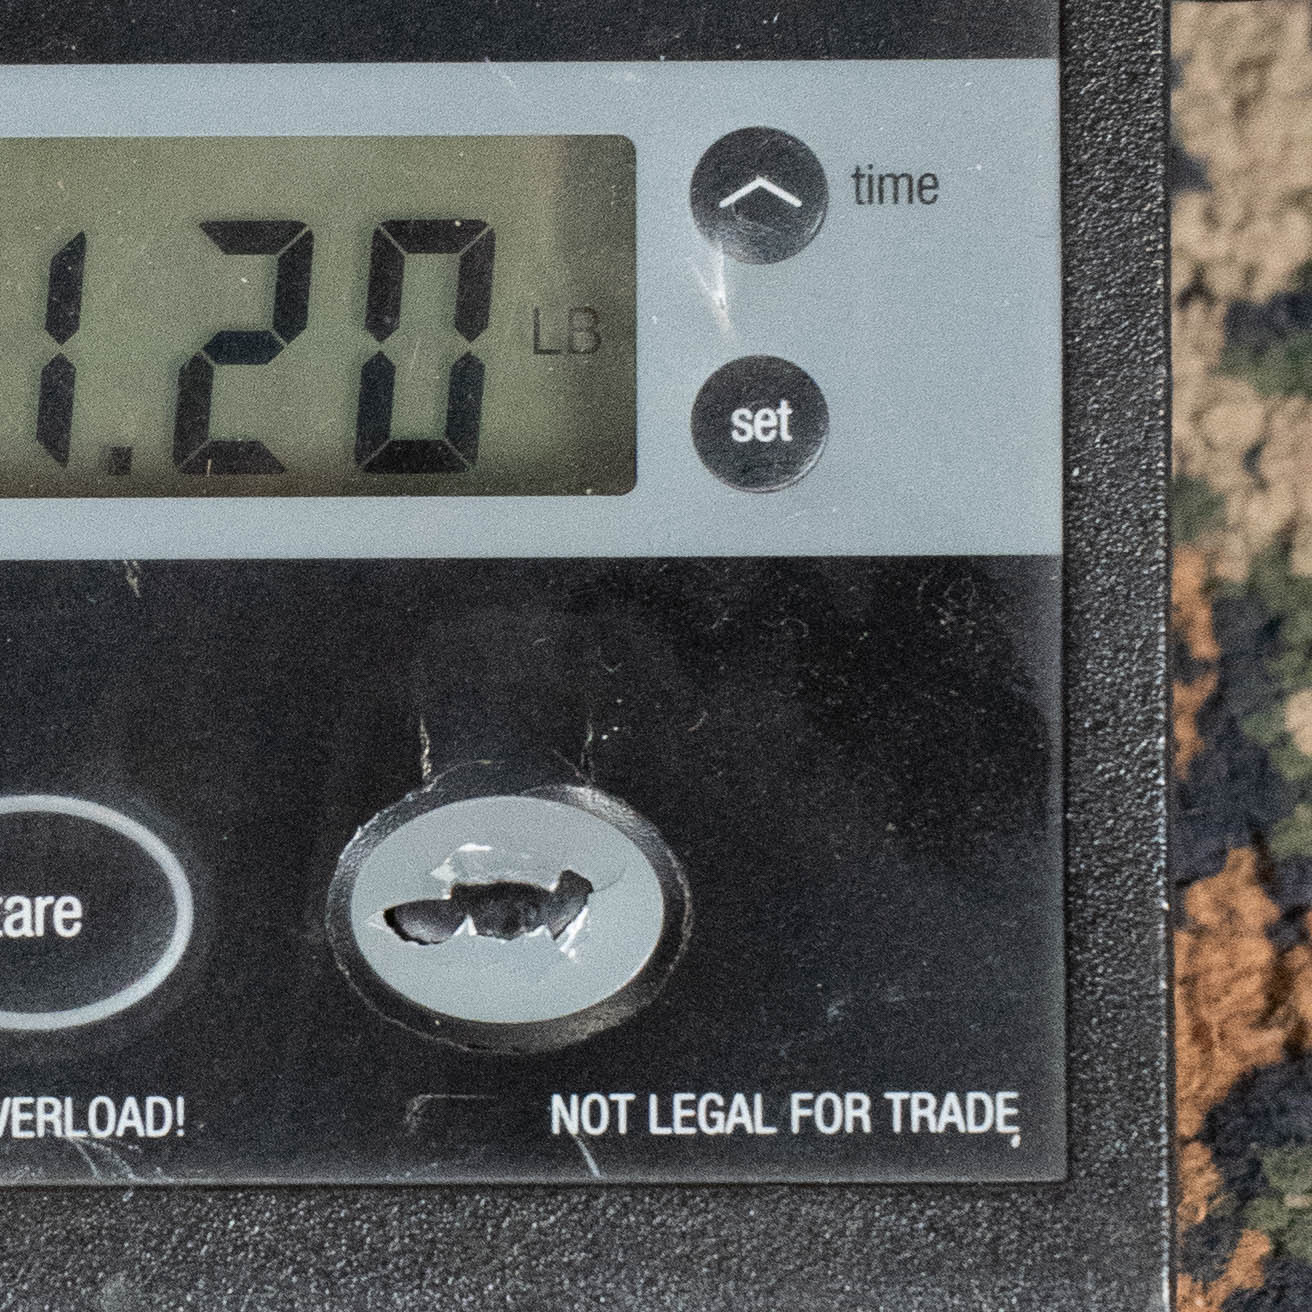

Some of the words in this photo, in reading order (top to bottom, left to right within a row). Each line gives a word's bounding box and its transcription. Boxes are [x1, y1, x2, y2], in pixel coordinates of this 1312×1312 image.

[852, 163, 940, 207] time
[530, 305, 603, 357] LB
[730, 397, 792, 444] set
[550, 1093, 636, 1136] NOT
[648, 1092, 777, 1135] LEGAL
[790, 1092, 872, 1134] FOR
[883, 1091, 1020, 1135] TRADE
